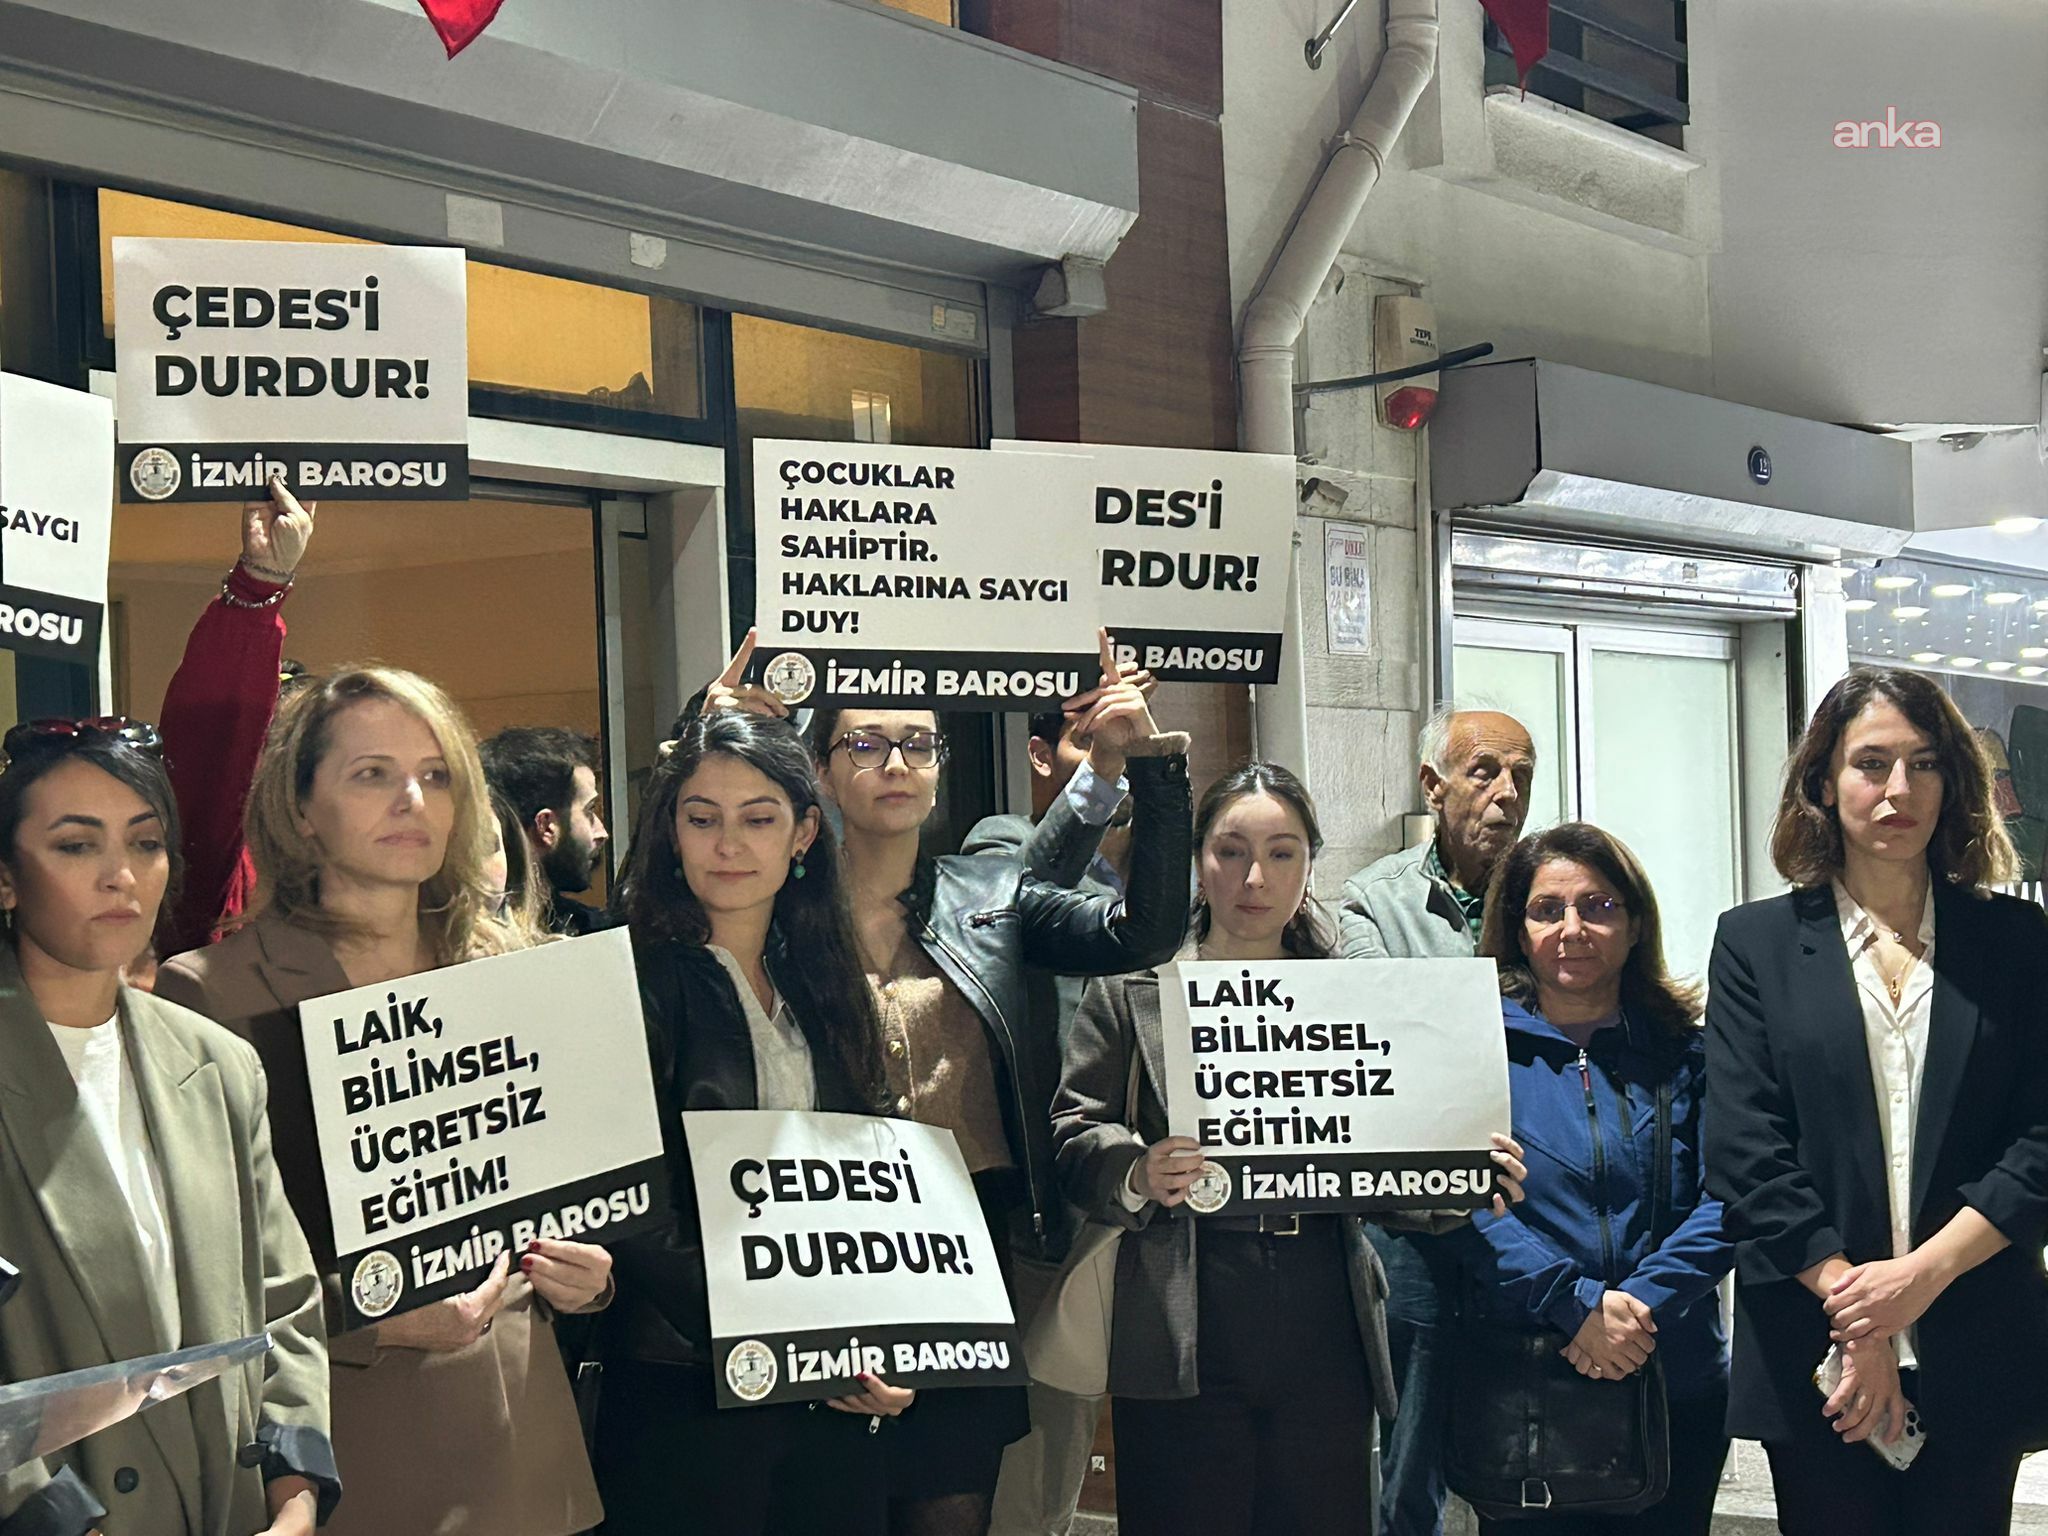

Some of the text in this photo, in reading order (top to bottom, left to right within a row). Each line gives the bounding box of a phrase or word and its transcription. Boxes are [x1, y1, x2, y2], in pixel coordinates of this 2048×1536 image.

[153, 275, 379, 340] ÇEDES'İ
[155, 355, 429, 400] DURDUR!
[191, 452, 288, 487] İZMİR
[299, 461, 447, 487] BAROSU
[779, 460, 955, 490] ÇOCUKLAR
[781, 497, 937, 525] HAKLARA
[1095, 479, 1223, 529] DES'İ
[781, 528, 938, 562] SAHİPTİR.
[782, 572, 1068, 602] HAKLARINA SAYGI
[1097, 549, 1260, 592] RDUR!
[0, 603, 83, 645] ROSU
[781, 610, 859, 634] DUY!
[826, 658, 926, 695] İZMİR
[936, 670, 1079, 697] BAROSU
[1144, 645, 1264, 671] BAROSU
[1188, 969, 1295, 1012] LAİK,
[334, 992, 443, 1055] LAİK,
[1191, 1014, 1391, 1056] BİLİMSEL,
[342, 1036, 539, 1115] BİLİMSEL,
[1194, 1059, 1394, 1099] ÜCRETSİZ
[350, 1081, 546, 1173] ÜCRETSİZ
[1198, 1106, 1352, 1147] EĞİTİM!
[360, 1156, 510, 1236] EĞİTİM!
[730, 1148, 921, 1219] ÇEDES'İ
[1242, 1163, 1341, 1200] İZMİR
[1351, 1168, 1491, 1197] BAROSU
[410, 1225, 504, 1290] İZMİR
[511, 1182, 651, 1254] BAROSU
[740, 1231, 974, 1281] DURDUR!
[786, 1337, 886, 1383] İZMİR
[893, 1341, 1010, 1373] BAROSU
